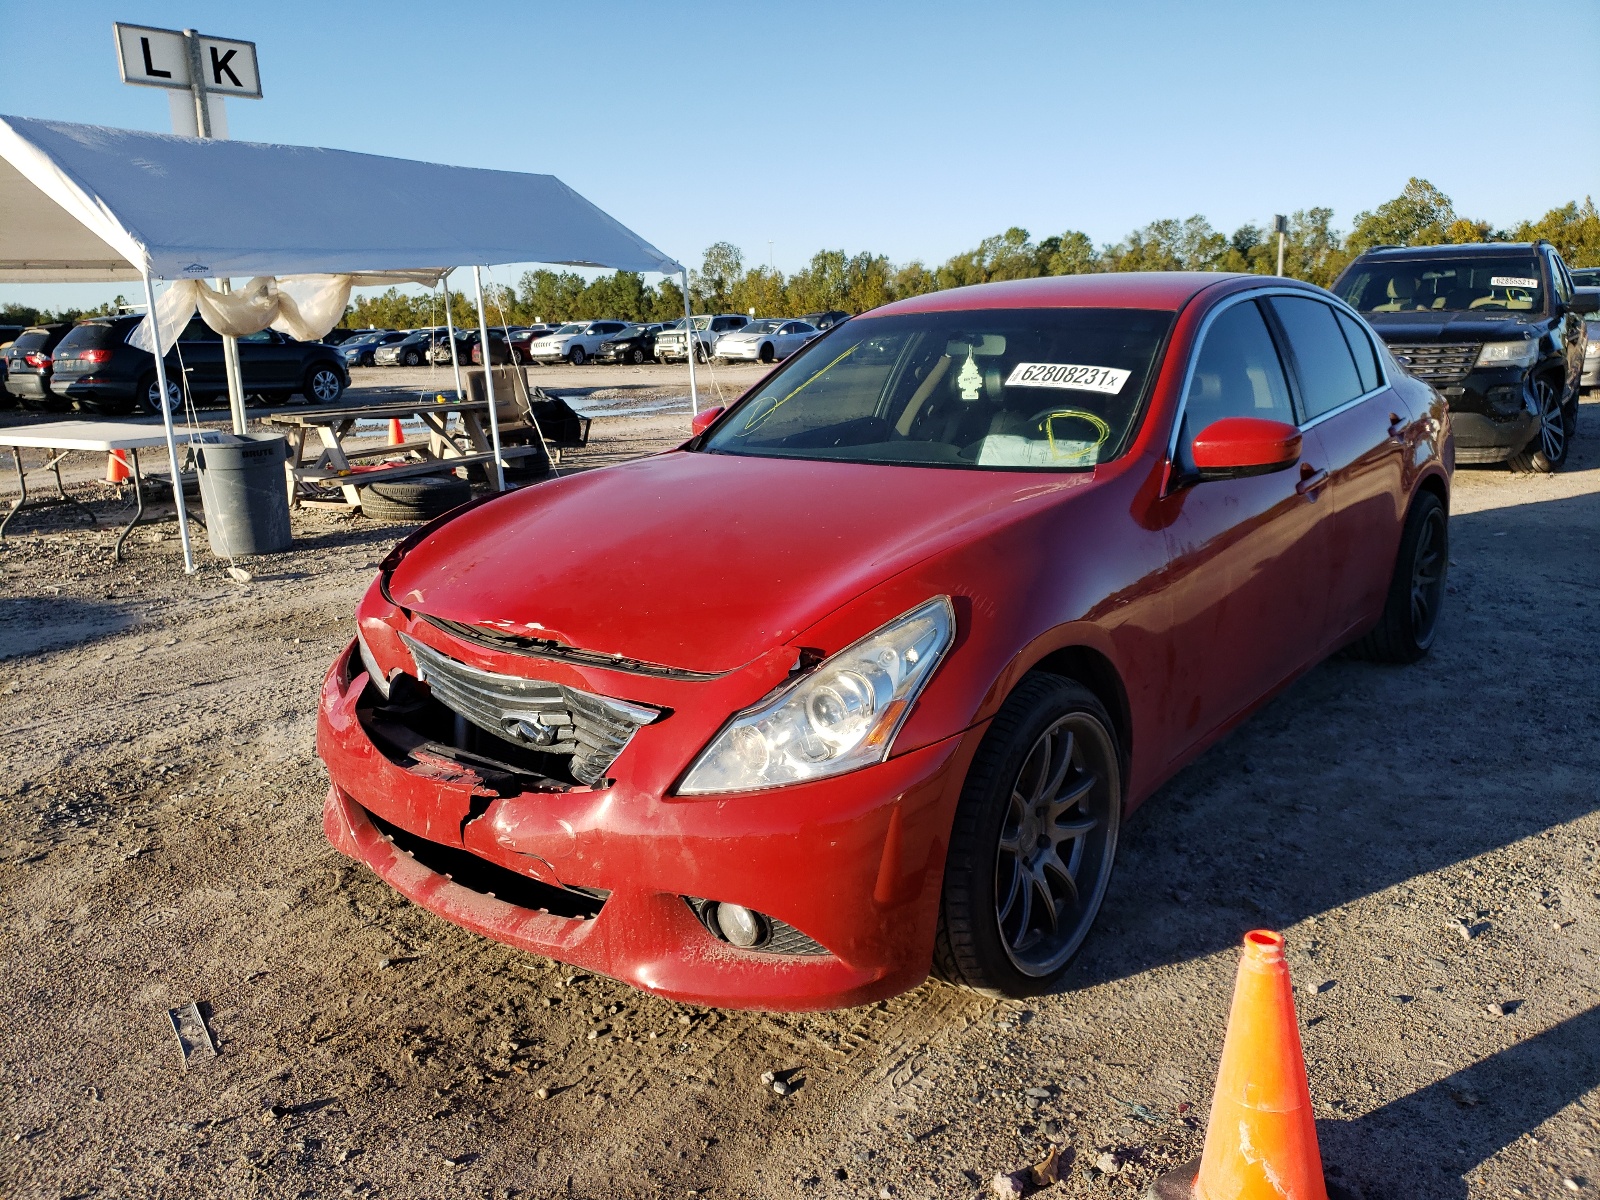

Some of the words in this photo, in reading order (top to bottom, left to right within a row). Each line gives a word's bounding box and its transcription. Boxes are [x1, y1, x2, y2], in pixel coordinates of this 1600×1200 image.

[140, 37, 171, 78] L
[210, 47, 243, 87] K
[242, 448, 274, 458] BRUTE
